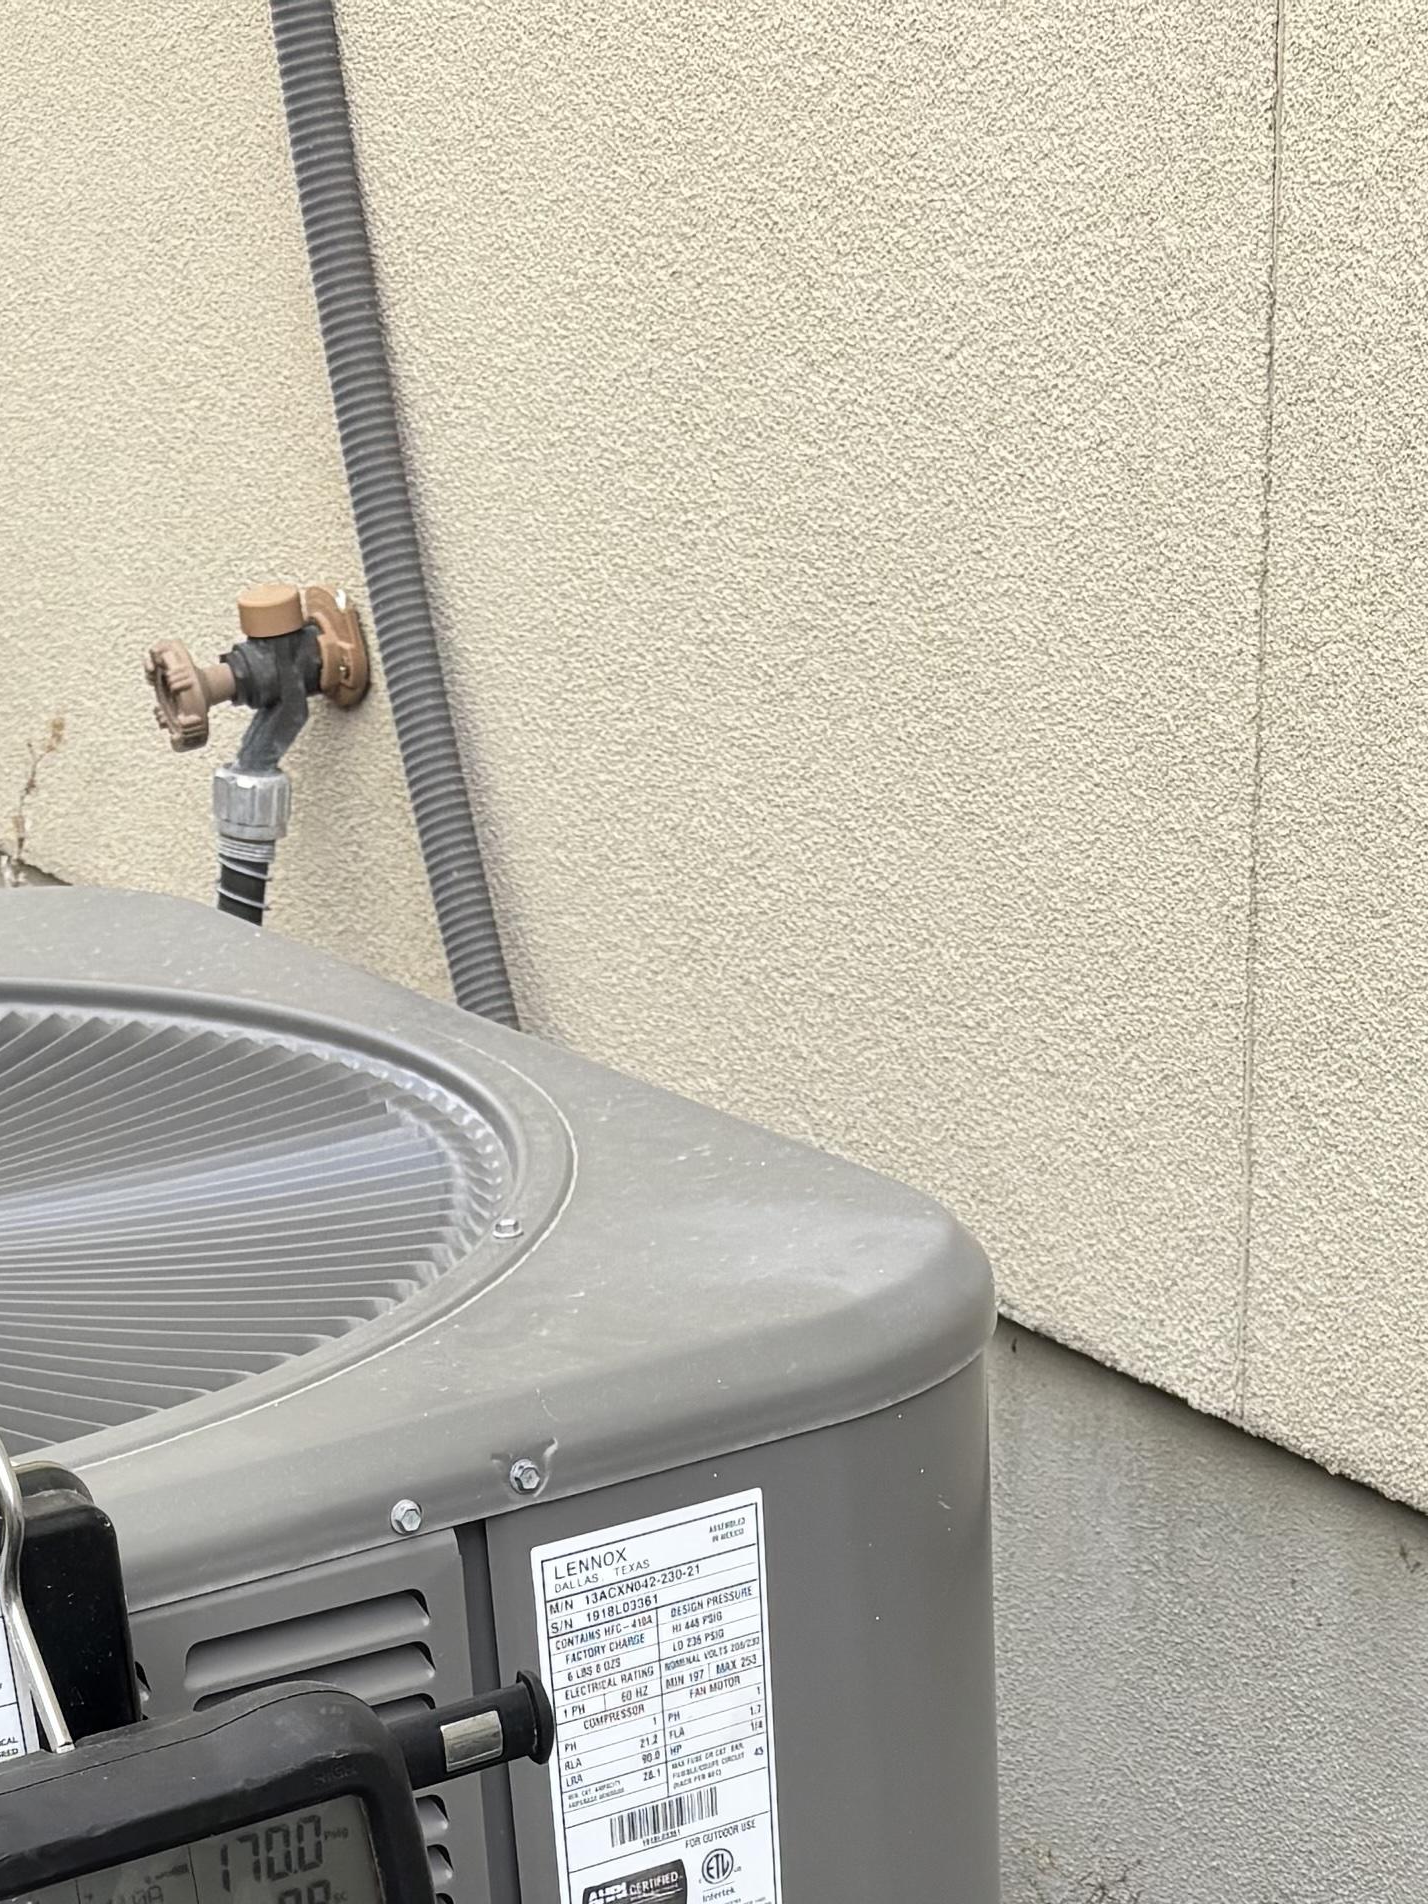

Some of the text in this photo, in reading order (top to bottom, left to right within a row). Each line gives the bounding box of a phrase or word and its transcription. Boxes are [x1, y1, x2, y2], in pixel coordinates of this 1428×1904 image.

[554, 1548, 627, 1580] LENNOX
[615, 1559, 650, 1577] TEXAS
[549, 1564, 701, 1614] M/N 13ACXN042-230-21
[671, 1586, 753, 1617] DESIGN PRESSURE
[551, 1594, 659, 1634] S/N 1918L03361
[702, 1612, 722, 1625] PSIG
[556, 1626, 601, 1650] CONTAINS
[704, 1629, 725, 1641] PSIG
[566, 1632, 646, 1664] FACTORY CHARGE
[576, 1667, 592, 1679] LBS
[716, 1654, 757, 1674] MAX 253
[565, 1666, 654, 1700] ELECTRICAL RATING
[666, 1670, 704, 1689] MIN 197
[689, 1676, 741, 1699] FAN MOTOR
[635, 1686, 649, 1698] HZ
[572, 1704, 586, 1715] PH
[583, 1703, 645, 1730] COMPRESSOR
[668, 1712, 681, 1722] PH
[669, 1727, 685, 1739] FLA
[685, 1820, 757, 1849] FOR OUTDOOR USE
[220, 1815, 323, 1893] 170.0
[702, 1887, 736, 1903] Intertek
